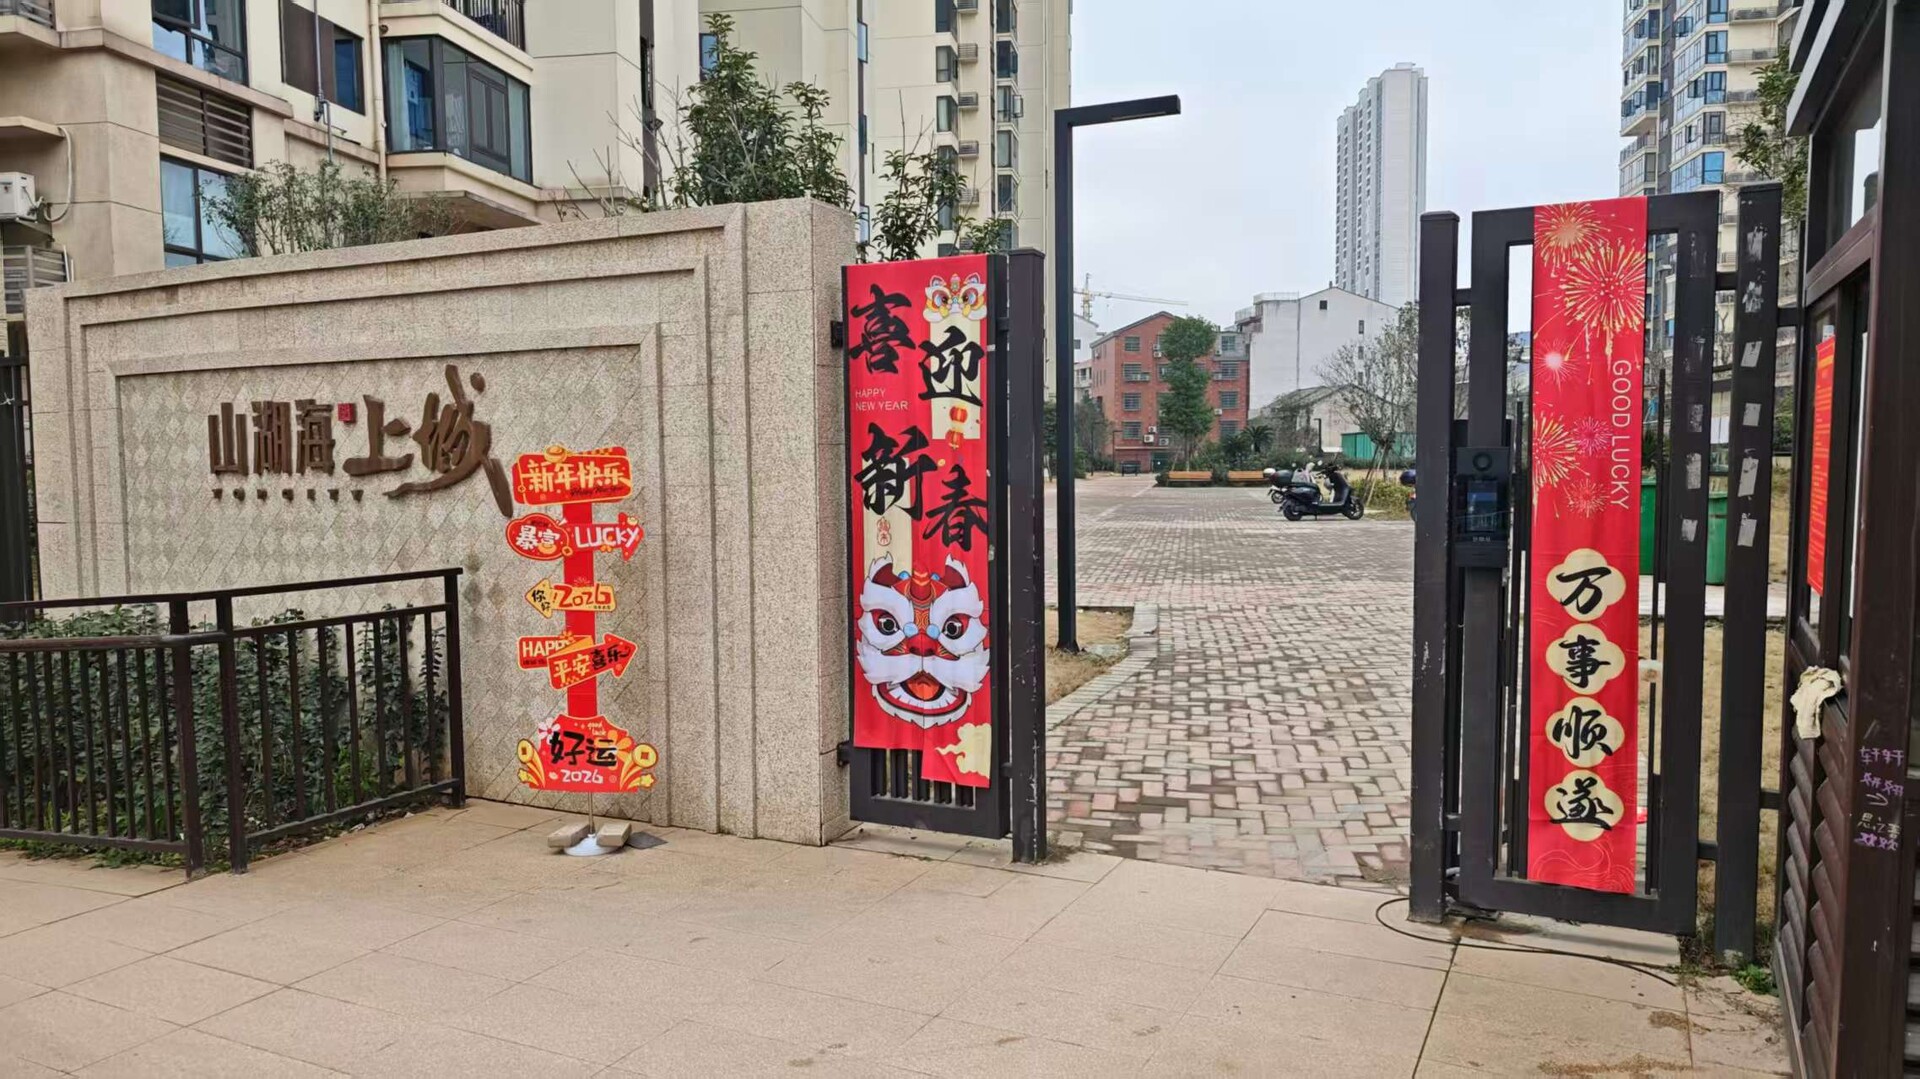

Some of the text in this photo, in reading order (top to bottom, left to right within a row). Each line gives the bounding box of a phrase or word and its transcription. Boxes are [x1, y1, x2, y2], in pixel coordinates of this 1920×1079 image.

[855, 388, 886, 398] HAPPY
[855, 400, 909, 411] NEW YEAR
[1610, 360, 1632, 509] GOOD LUCKY
[522, 459, 631, 493] 新年快乐
[575, 527, 640, 548] LUCKY
[554, 583, 612, 608] 2026
[522, 639, 572, 658] HAPP
[553, 644, 631, 683] 平安喜乐
[1550, 566, 1614, 831] 万事顺遂
[550, 731, 617, 766] 好运
[560, 769, 603, 784] 2026
